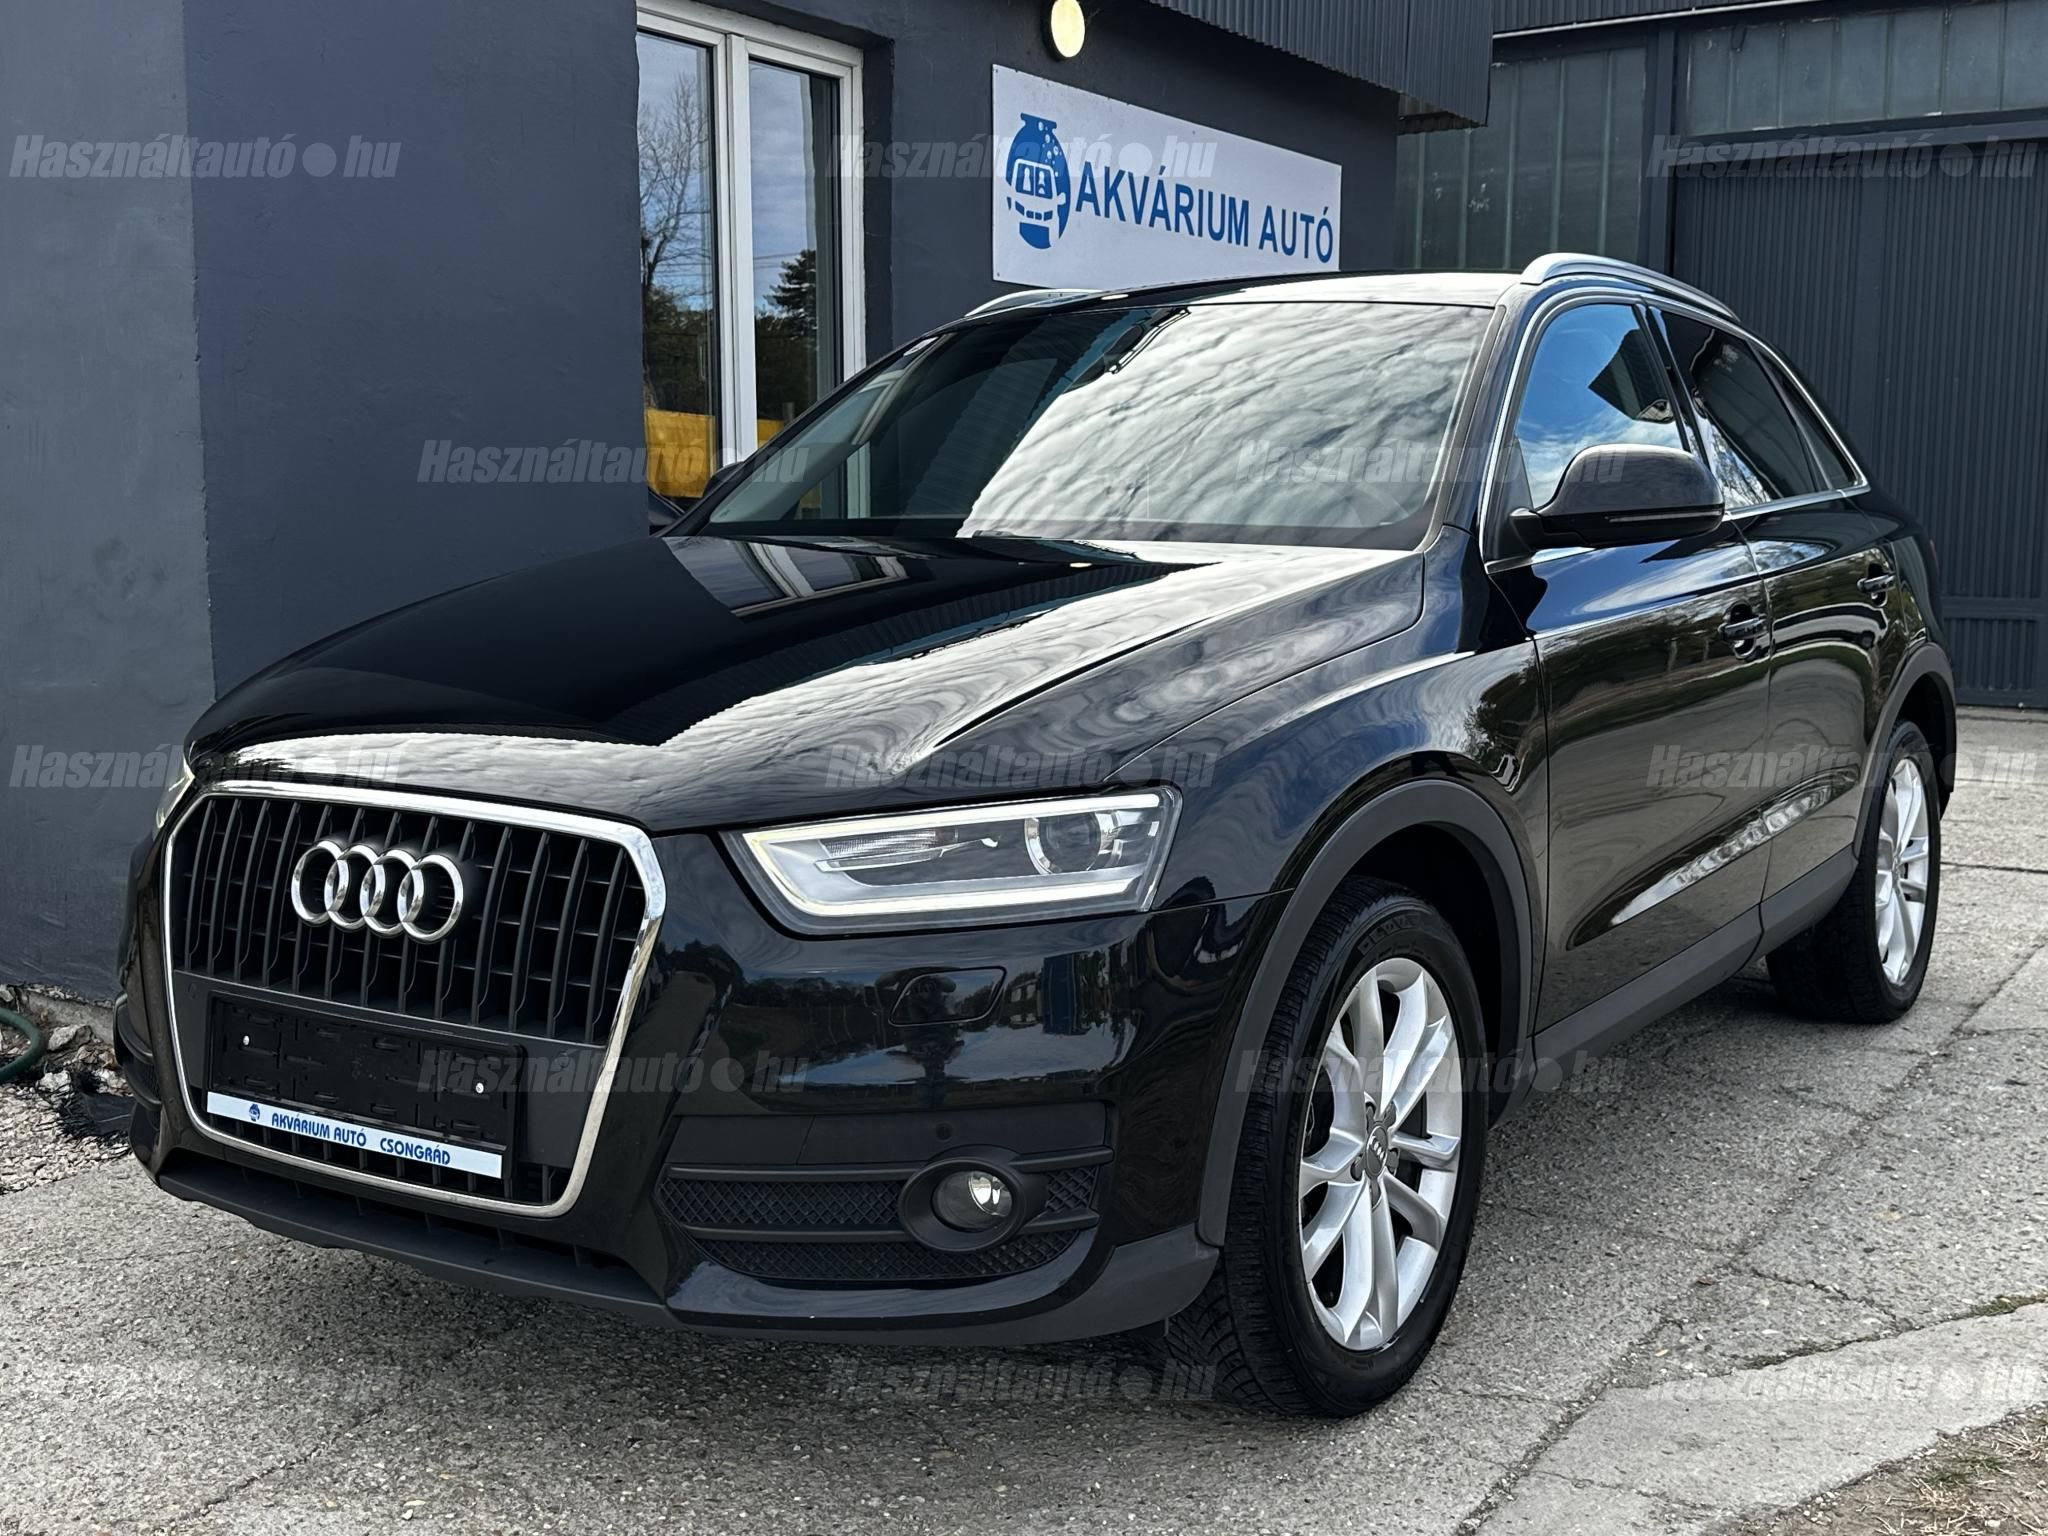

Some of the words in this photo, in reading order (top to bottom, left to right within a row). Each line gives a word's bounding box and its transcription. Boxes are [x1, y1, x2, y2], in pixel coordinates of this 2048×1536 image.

[1075, 160, 1249, 248] AKVÁRIUM
[1258, 206, 1333, 264] AUTÓ
[271, 1113, 330, 1139] AKVÁRIUM
[334, 1127, 367, 1147] AUTÓ
[380, 1138, 451, 1166] CSONGRÁD
